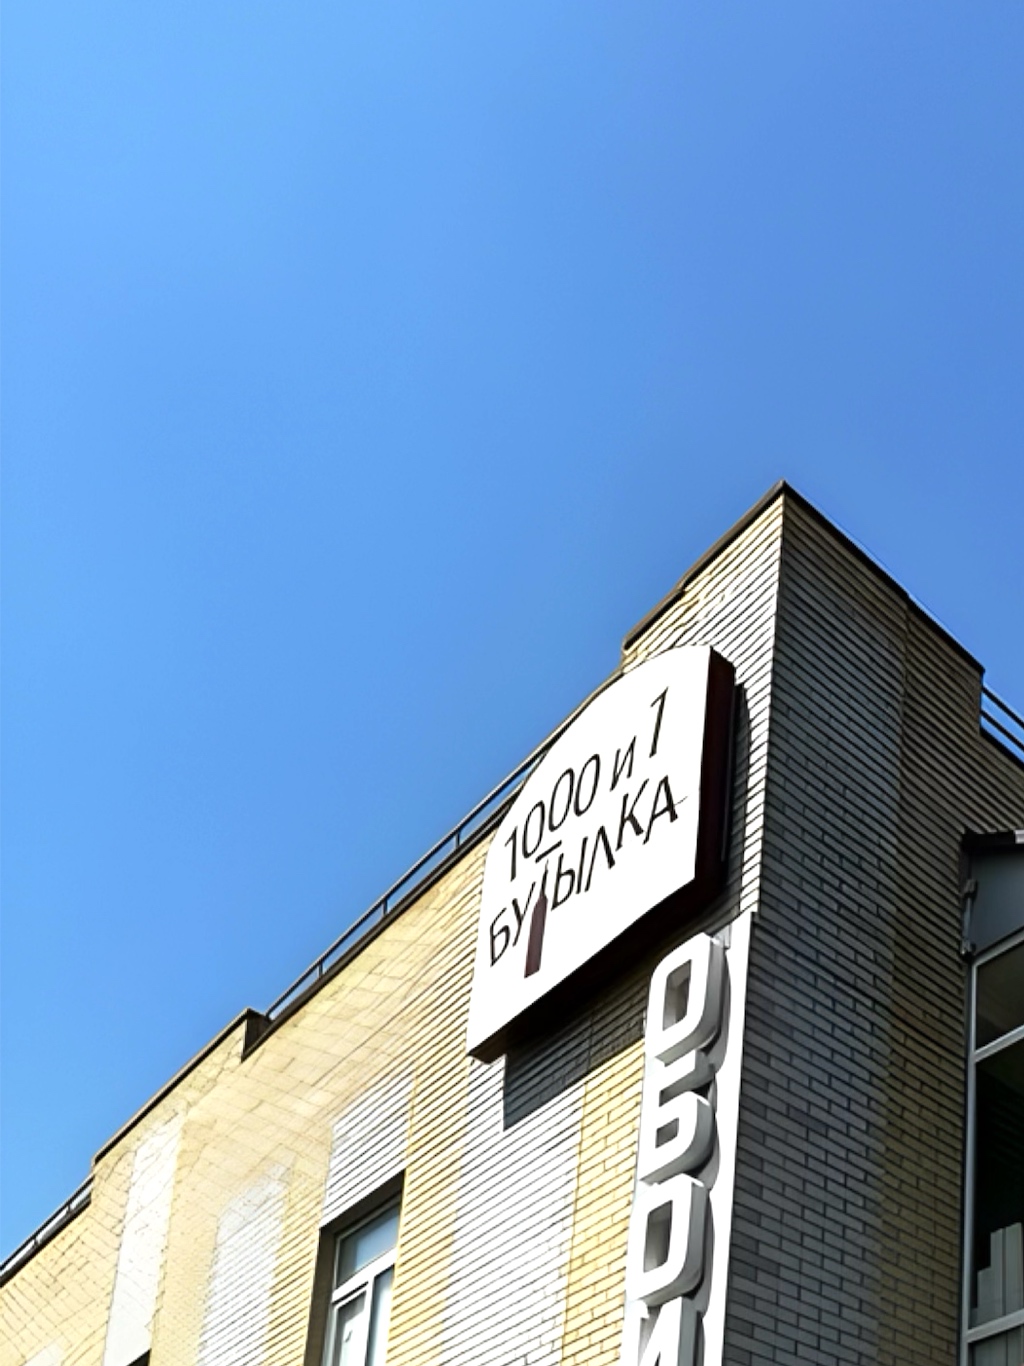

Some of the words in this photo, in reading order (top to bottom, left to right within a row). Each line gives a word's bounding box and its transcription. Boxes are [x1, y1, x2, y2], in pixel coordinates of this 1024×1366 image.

[489, 775, 680, 979] БУТЫЛКА
[504, 753, 601, 882] 1000
[649, 686, 669, 758] 1
